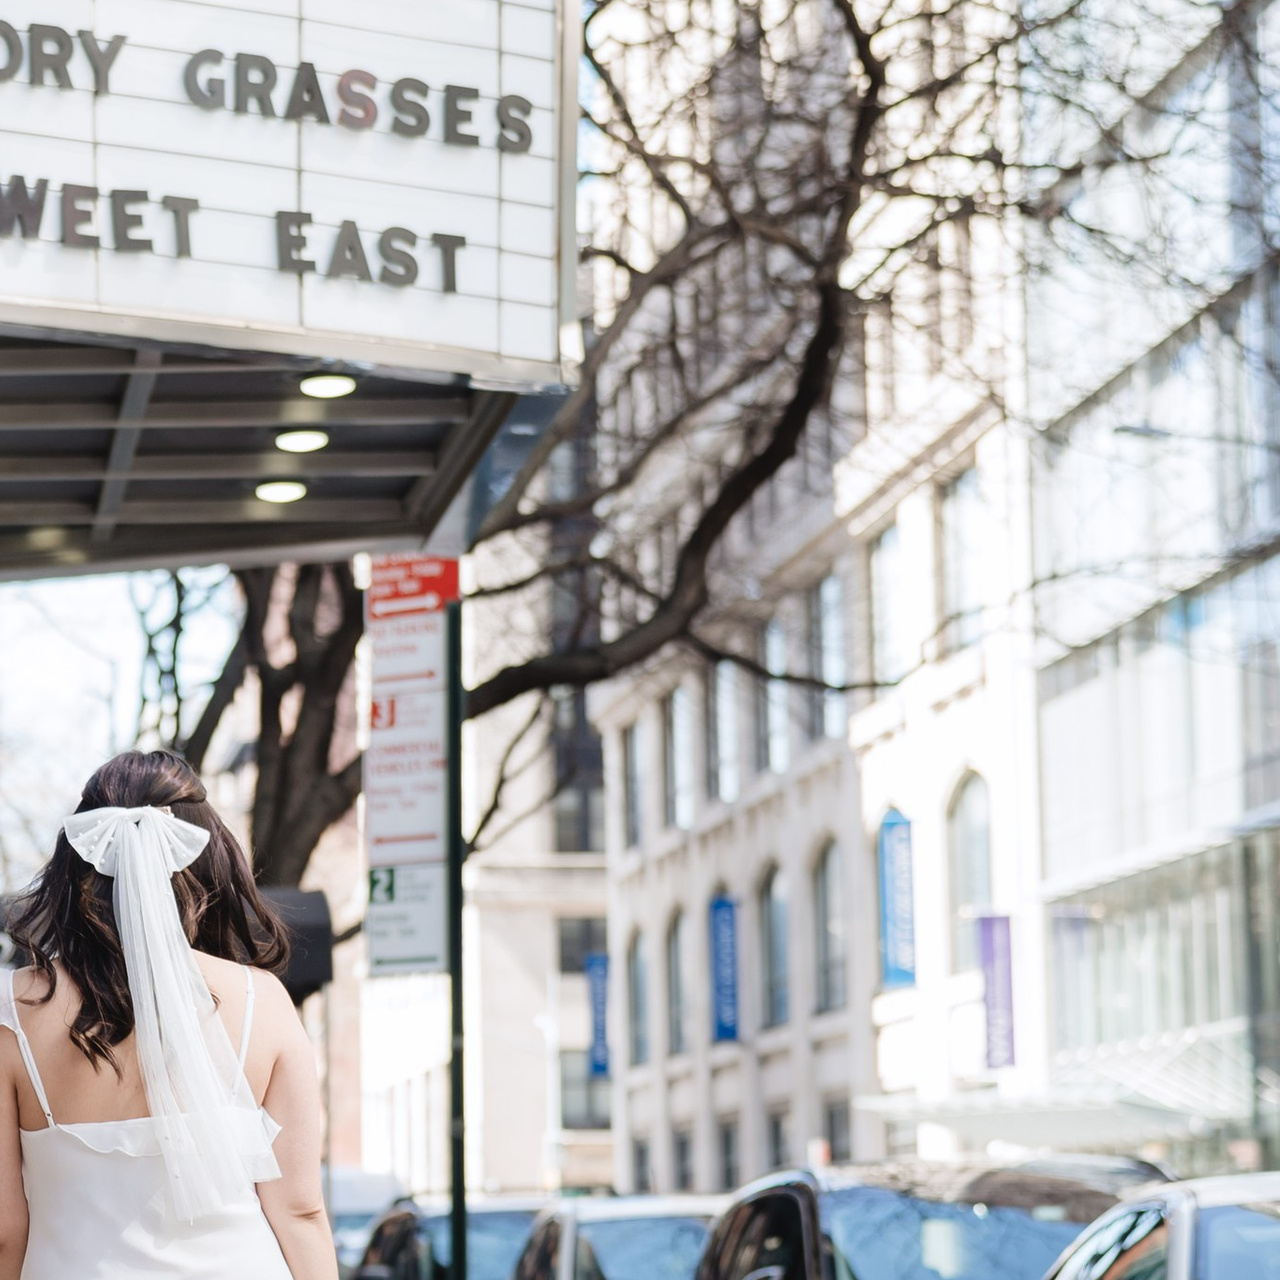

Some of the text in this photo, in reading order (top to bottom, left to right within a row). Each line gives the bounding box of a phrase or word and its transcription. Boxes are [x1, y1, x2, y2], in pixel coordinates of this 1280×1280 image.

[183, 48, 533, 154] GRASSES
[276, 209, 467, 293] EAST
[371, 868, 392, 904] 2
